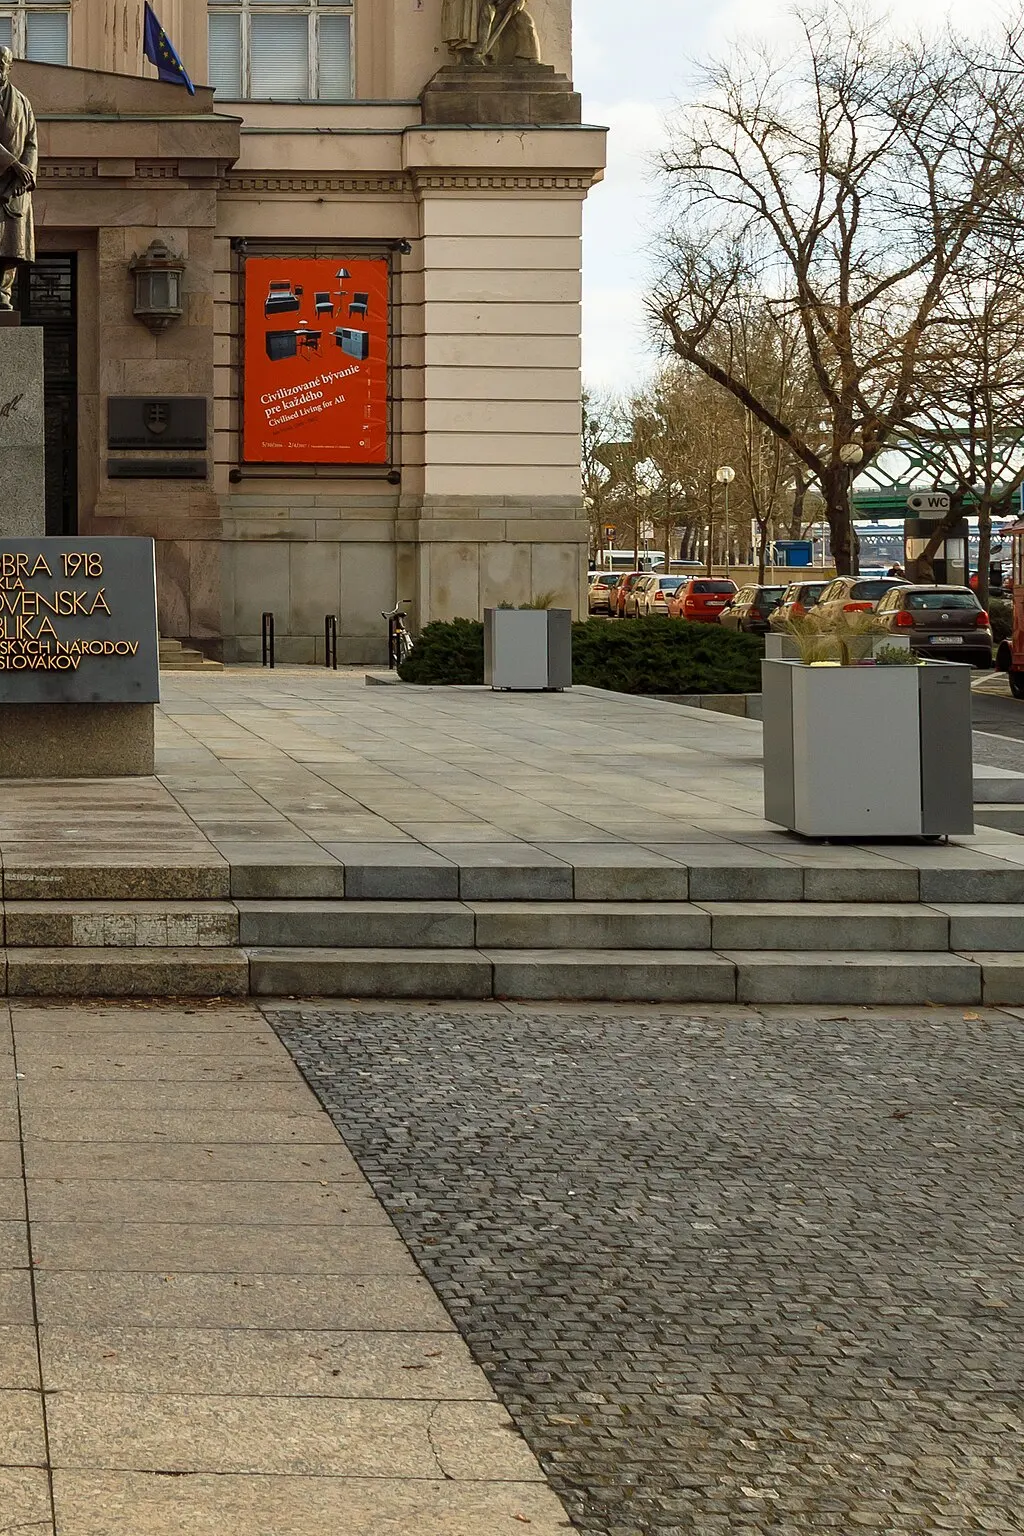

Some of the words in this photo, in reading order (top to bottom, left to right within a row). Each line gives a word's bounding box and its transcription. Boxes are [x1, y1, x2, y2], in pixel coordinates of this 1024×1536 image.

[260, 376, 321, 405] Civilizované
[321, 364, 360, 385] bývanie
[265, 405, 281, 419] pre
[281, 390, 323, 410] každého
[268, 411, 299, 427] Civilised
[299, 404, 323, 417] Living
[322, 400, 333, 409] for
[334, 395, 346, 405] All
[928, 497, 948, 508] WC
[61, 553, 103, 578] 1918
[56, 638, 139, 655] NÁRODOV
